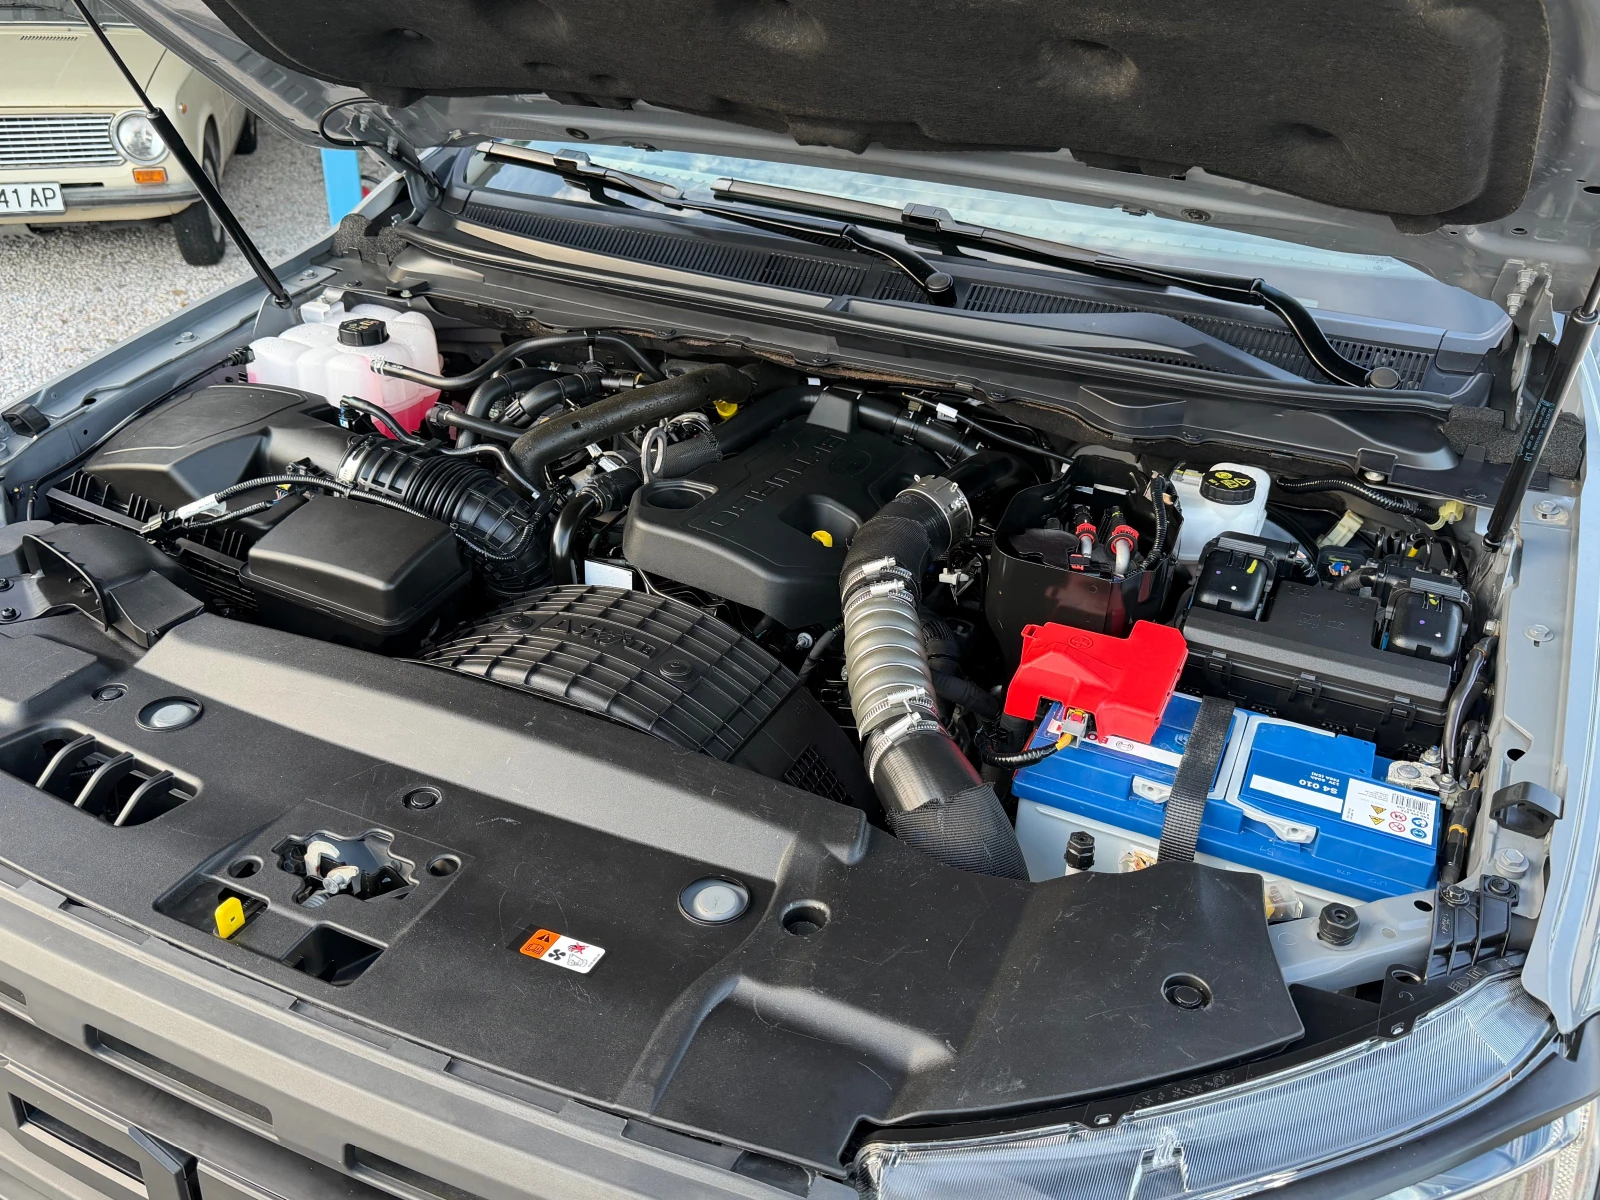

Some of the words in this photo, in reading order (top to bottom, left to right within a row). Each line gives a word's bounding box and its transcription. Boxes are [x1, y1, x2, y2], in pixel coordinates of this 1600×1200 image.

[31, 187, 56, 207] AP
[1298, 779, 1320, 789] 010
[1322, 785, 1338, 795] S4
